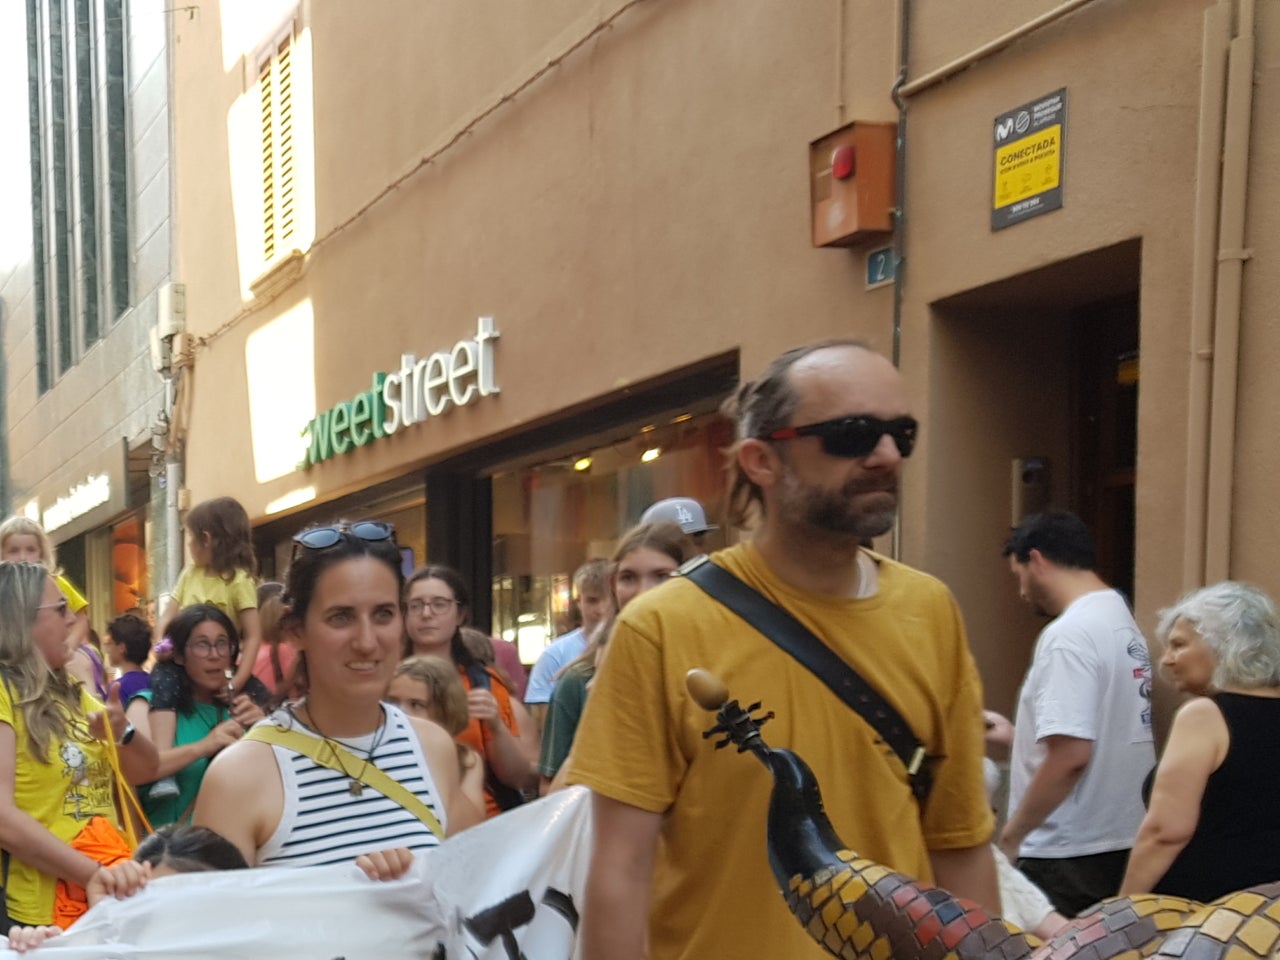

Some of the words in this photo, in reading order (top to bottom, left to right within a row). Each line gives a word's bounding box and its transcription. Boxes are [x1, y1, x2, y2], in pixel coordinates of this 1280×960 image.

[1000, 136, 1056, 166] CONECTADA
[877, 253, 886, 281] 2
[675, 503, 694, 525] LA
